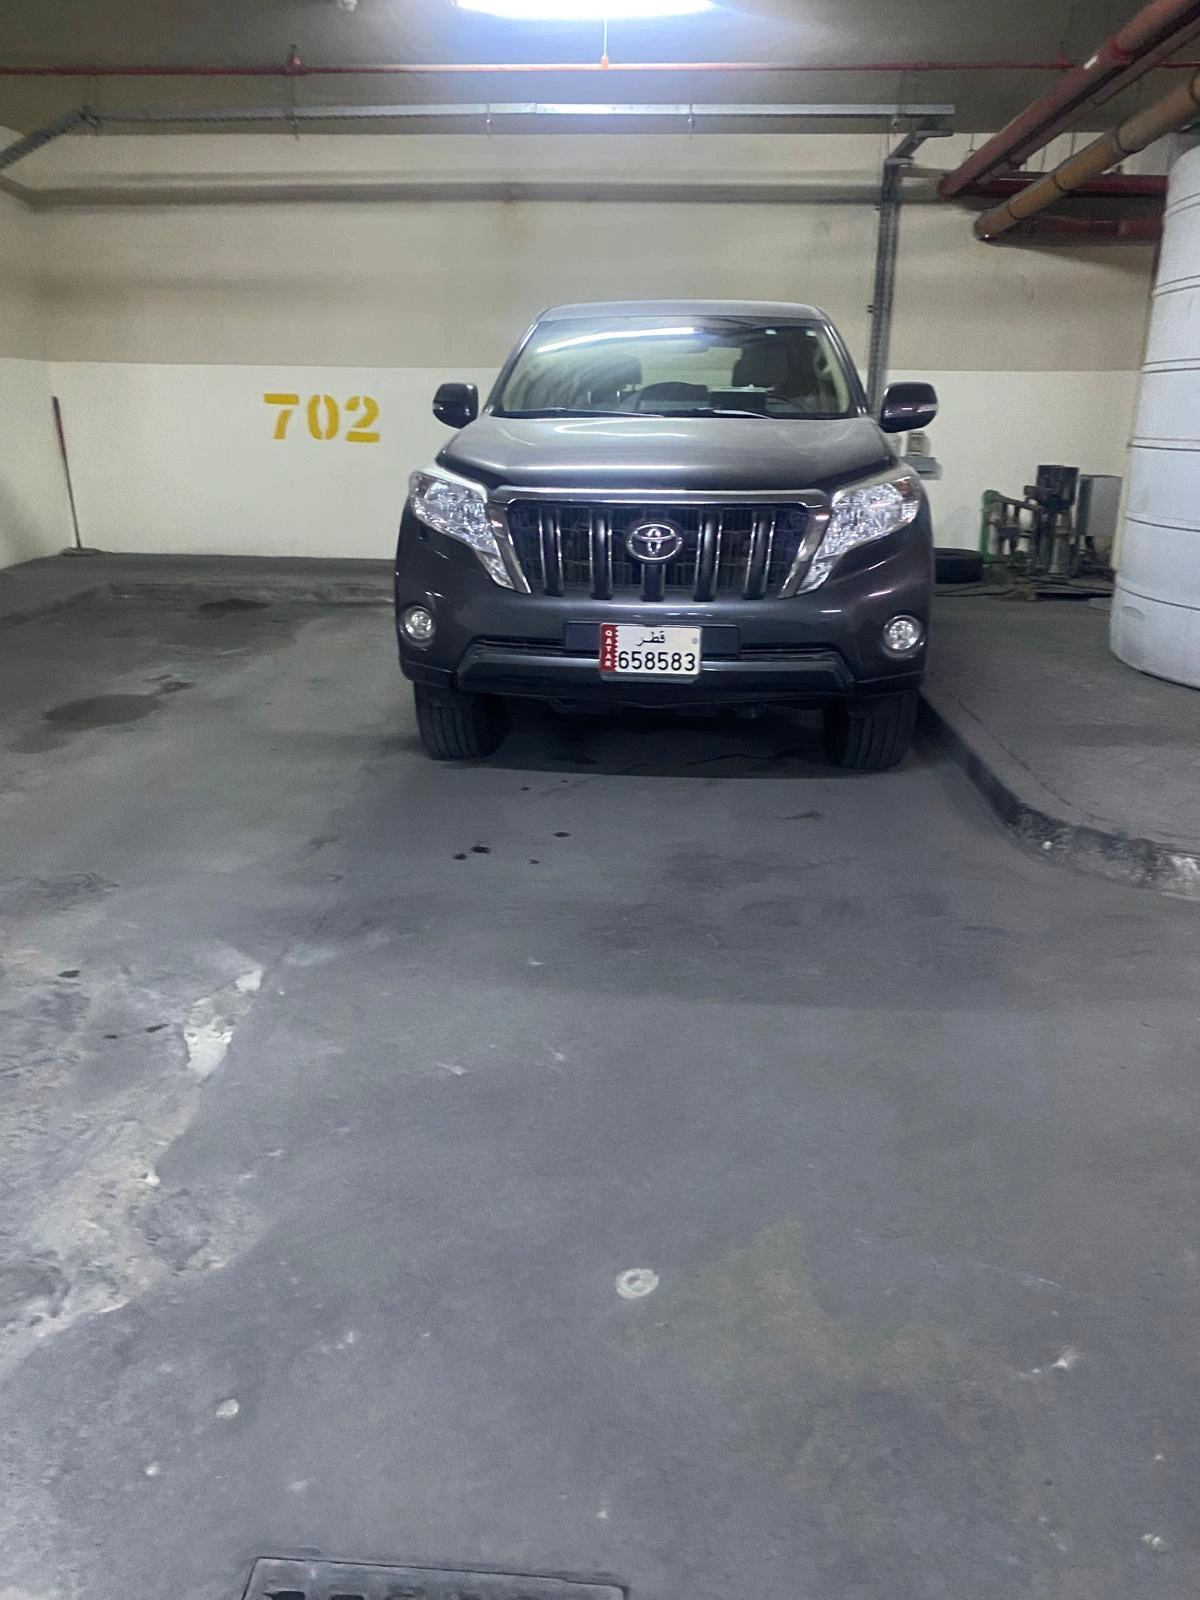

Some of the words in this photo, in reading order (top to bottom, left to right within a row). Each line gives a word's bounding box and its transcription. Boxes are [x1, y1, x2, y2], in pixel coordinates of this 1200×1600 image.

[263, 393, 380, 443] 702
[634, 630, 665, 647] قطر
[618, 650, 695, 671] 658583
